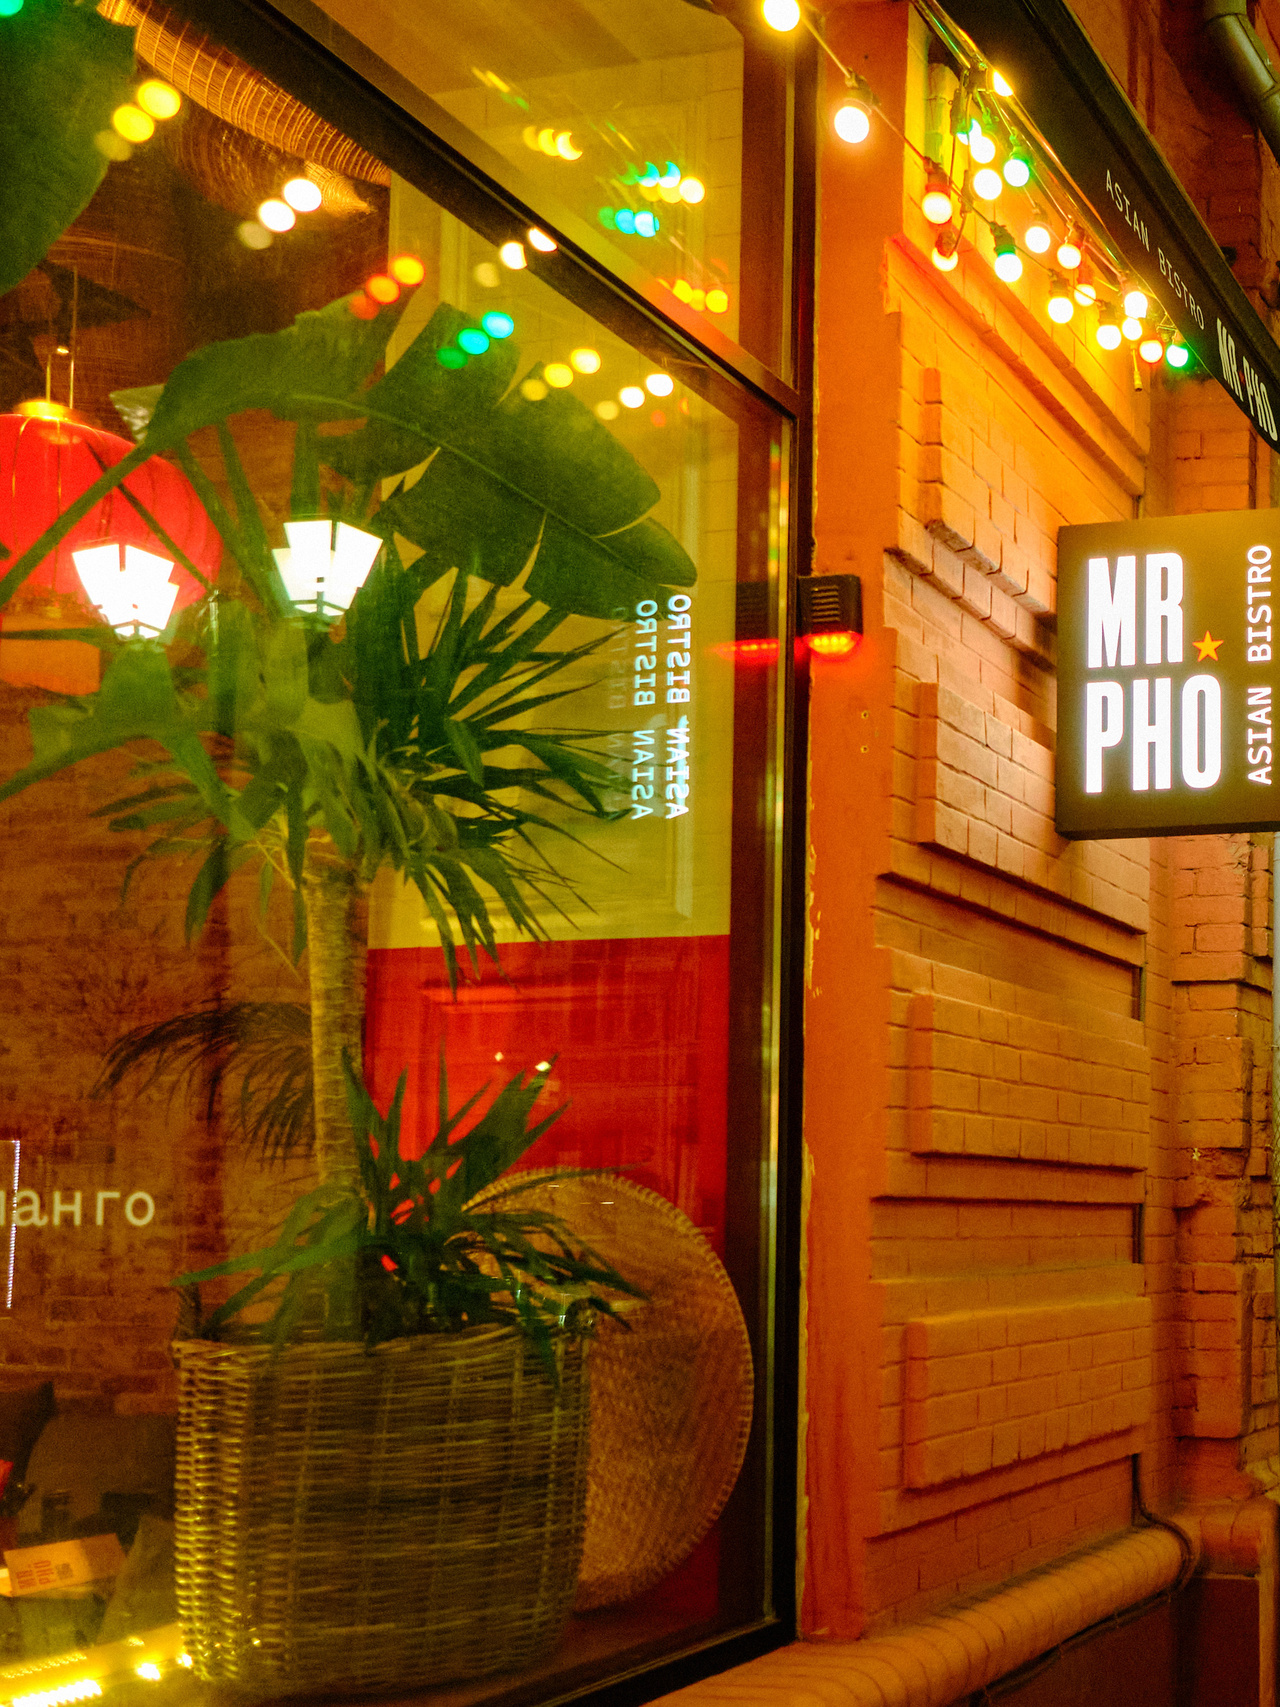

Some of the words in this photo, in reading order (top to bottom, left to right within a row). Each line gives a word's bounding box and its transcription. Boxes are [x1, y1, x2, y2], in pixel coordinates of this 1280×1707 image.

[1106, 169, 1150, 252] ASIAN
[1158, 247, 1204, 330] BISTRO
[1217, 318, 1243, 402] MR
[1242, 355, 1278, 441] PHO
[1087, 552, 1184, 668] MR
[1247, 544, 1272, 662] BISTRO
[1085, 673, 1222, 794] PHO
[1247, 686, 1272, 785] ASIAN
[0, 1187, 155, 1227] анго
